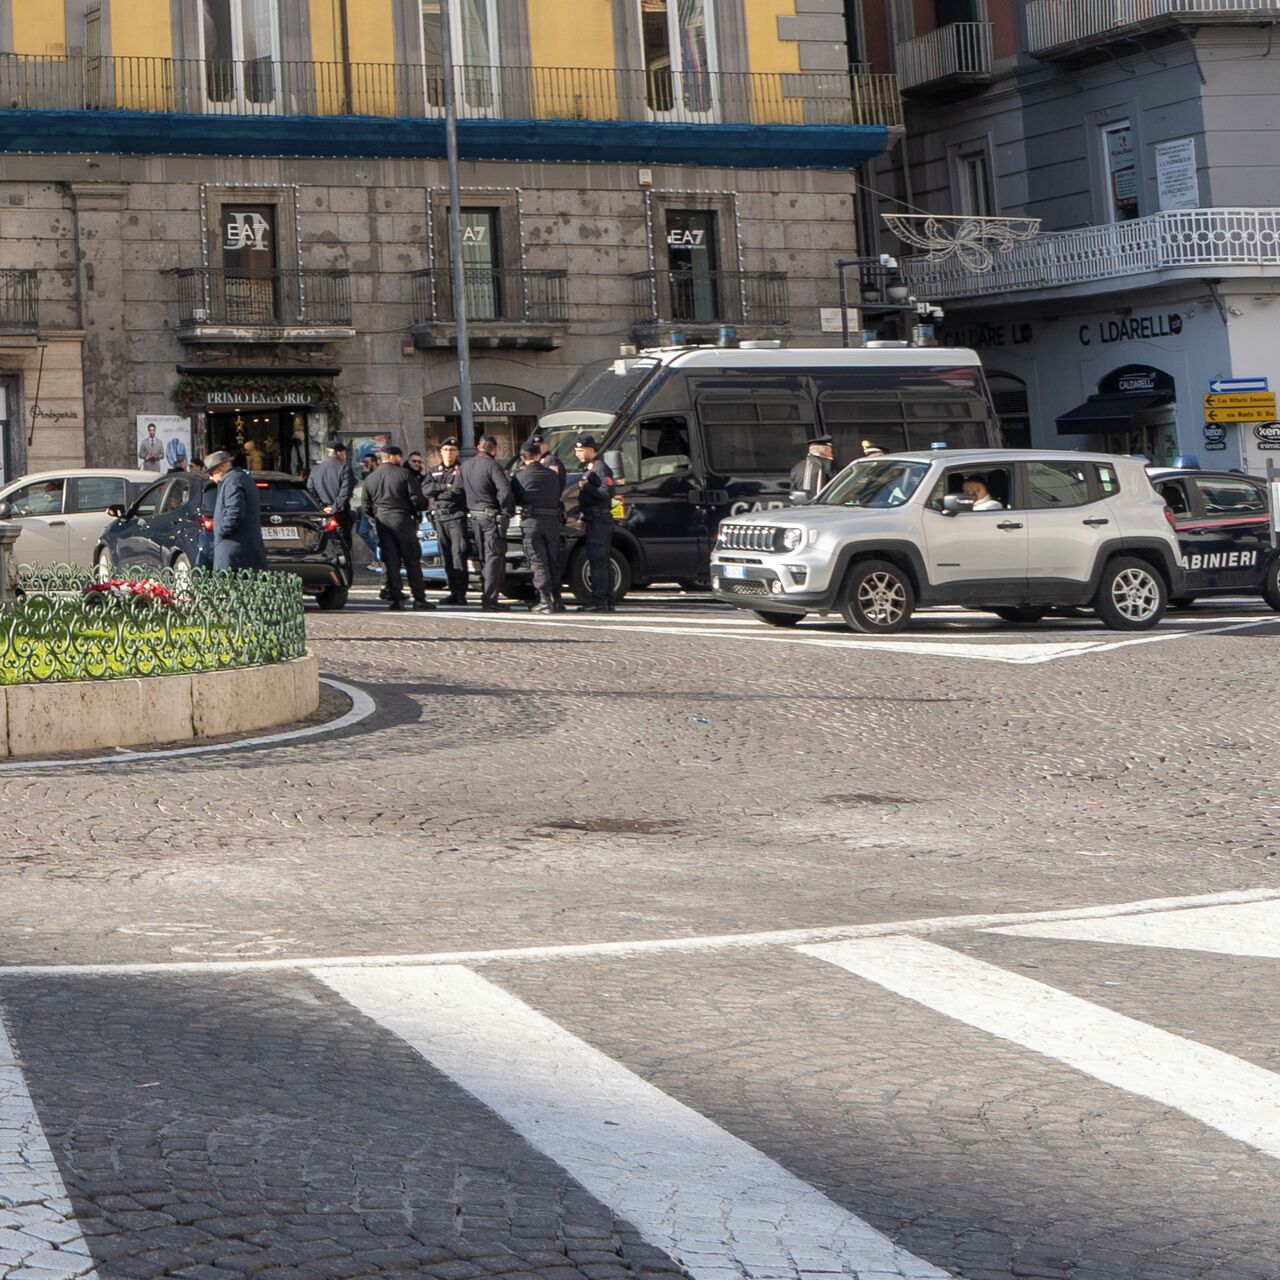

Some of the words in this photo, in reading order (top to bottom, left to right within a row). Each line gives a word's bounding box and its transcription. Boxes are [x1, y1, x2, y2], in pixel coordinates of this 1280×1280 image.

[460, 226, 486, 241] A7
[670, 229, 704, 244] EA7
[207, 392, 248, 404] PRIMO
[452, 396, 516, 412] MxMara
